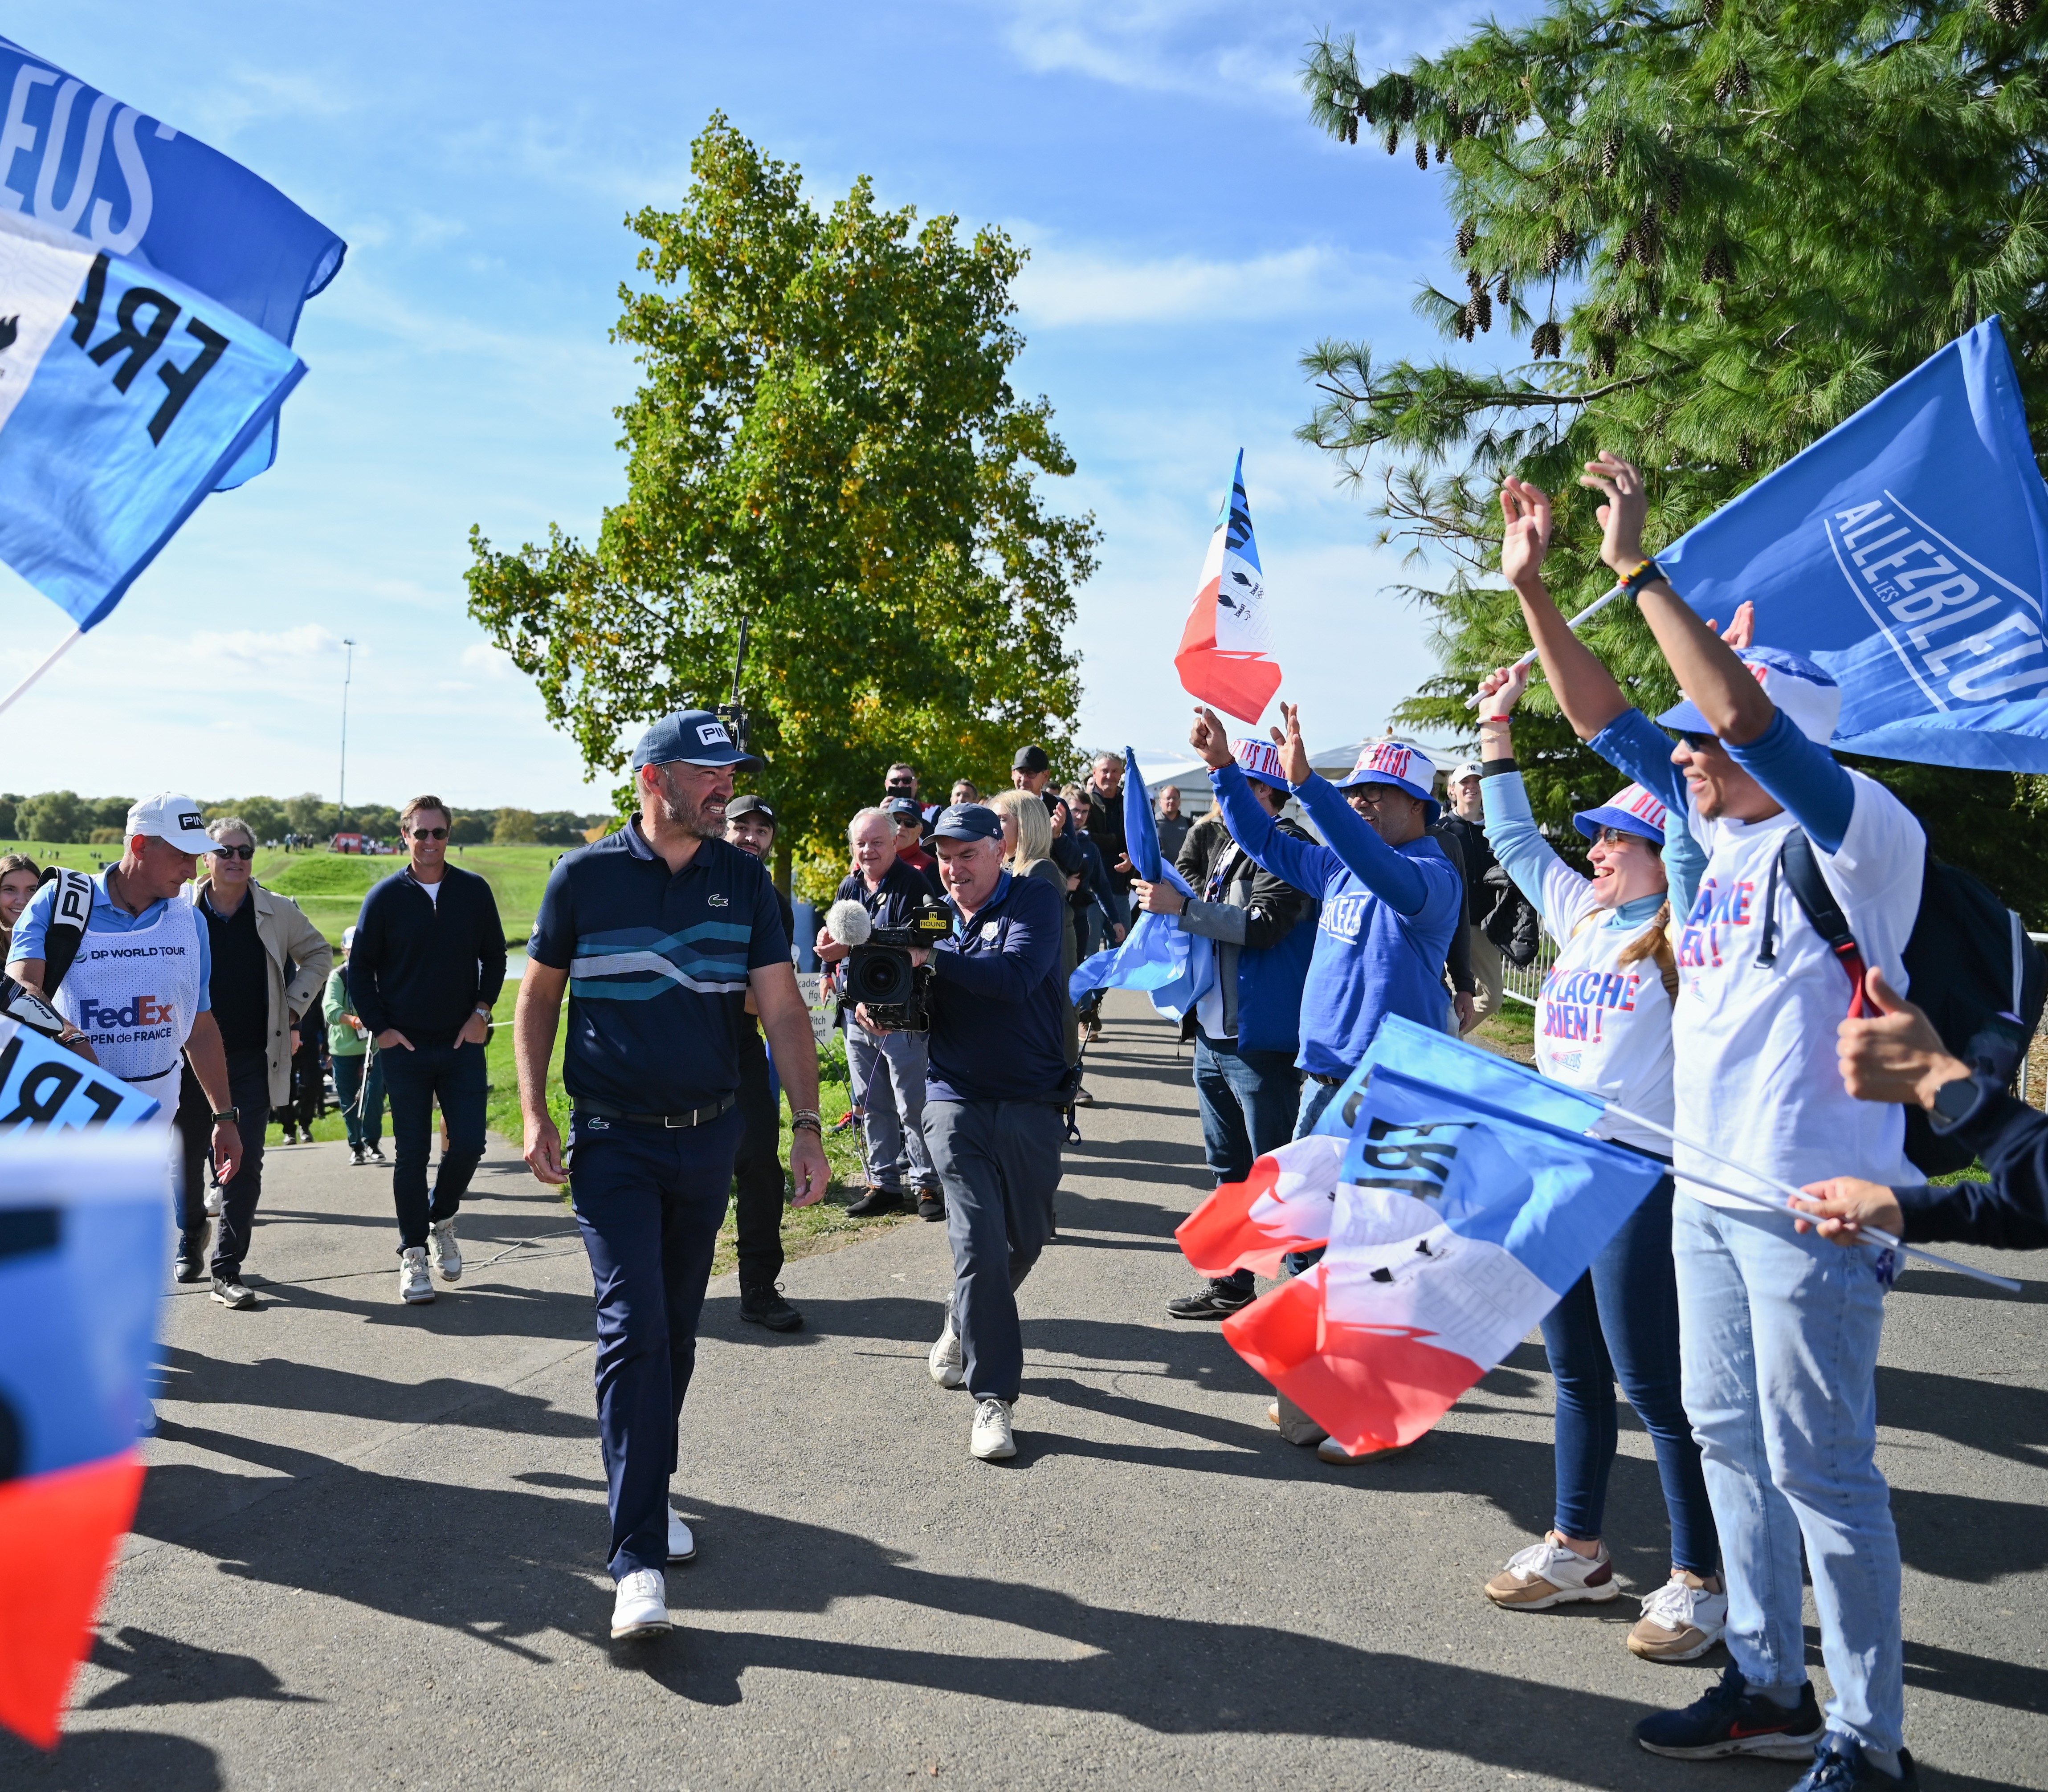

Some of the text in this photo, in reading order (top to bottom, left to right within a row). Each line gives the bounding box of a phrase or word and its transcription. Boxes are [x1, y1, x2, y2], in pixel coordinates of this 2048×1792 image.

[1835, 500, 2048, 705] ALLEZ BLEU
[1873, 581, 1899, 603] LES
[1262, 748, 1286, 779] BLEU
[91, 947, 186, 959] DP WORLD TOUR
[80, 995, 173, 1030] FedEx
[1543, 1001, 1588, 1041] RIEN
[88, 1027, 172, 1045] PEN de FRANCE
